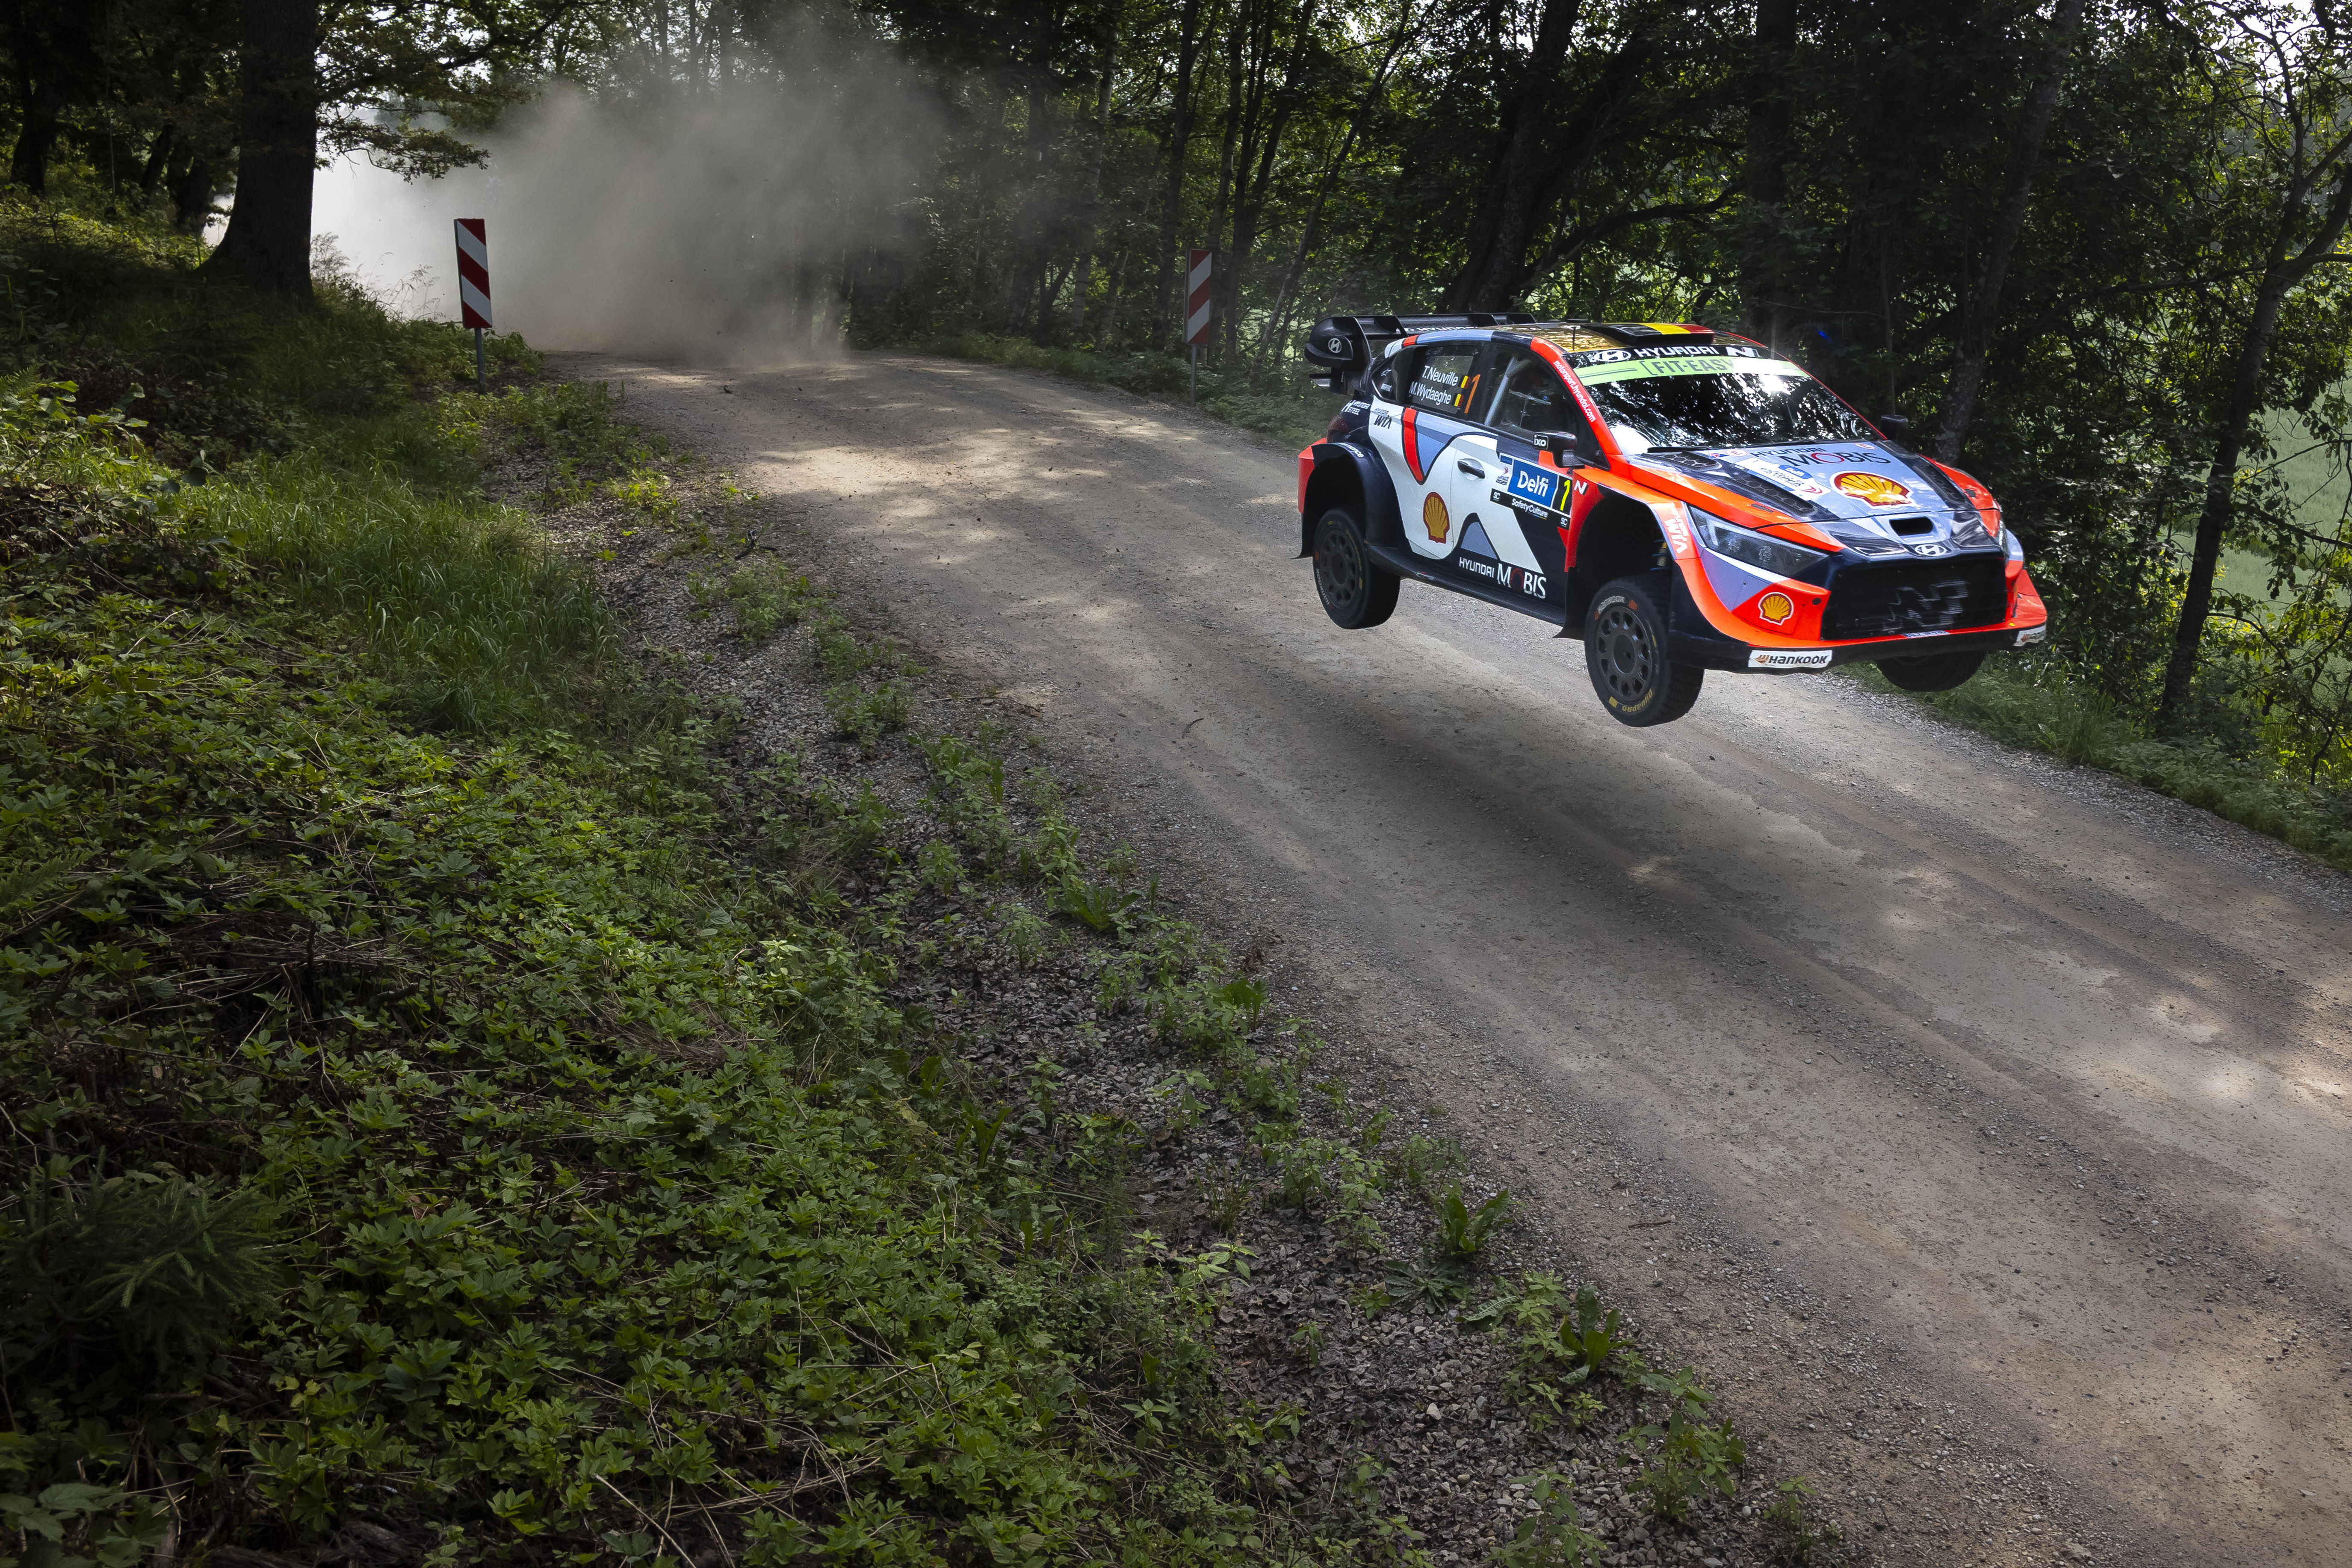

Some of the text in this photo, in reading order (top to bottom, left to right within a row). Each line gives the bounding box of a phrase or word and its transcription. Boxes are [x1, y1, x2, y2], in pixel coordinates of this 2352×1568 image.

[1633, 346, 1720, 357] HYUNDAI
[1422, 365, 1459, 386] T.Neuville
[1409, 381, 1452, 406] M.Wydaeghe
[1464, 374, 1481, 413] 1
[1553, 360, 1596, 422] motorsport.hyundai.com
[1347, 407, 1361, 415] STEEL
[1374, 415, 1392, 429] WIA
[1750, 448, 1827, 458] HYUNDAI
[1778, 452, 1891, 466] MOBIS
[1517, 470, 1549, 497] Delfi
[1560, 479, 1571, 511] 1
[1511, 498, 1548, 518] SafetyCulture
[1459, 557, 1547, 599] HYUNDAI MOBIS
